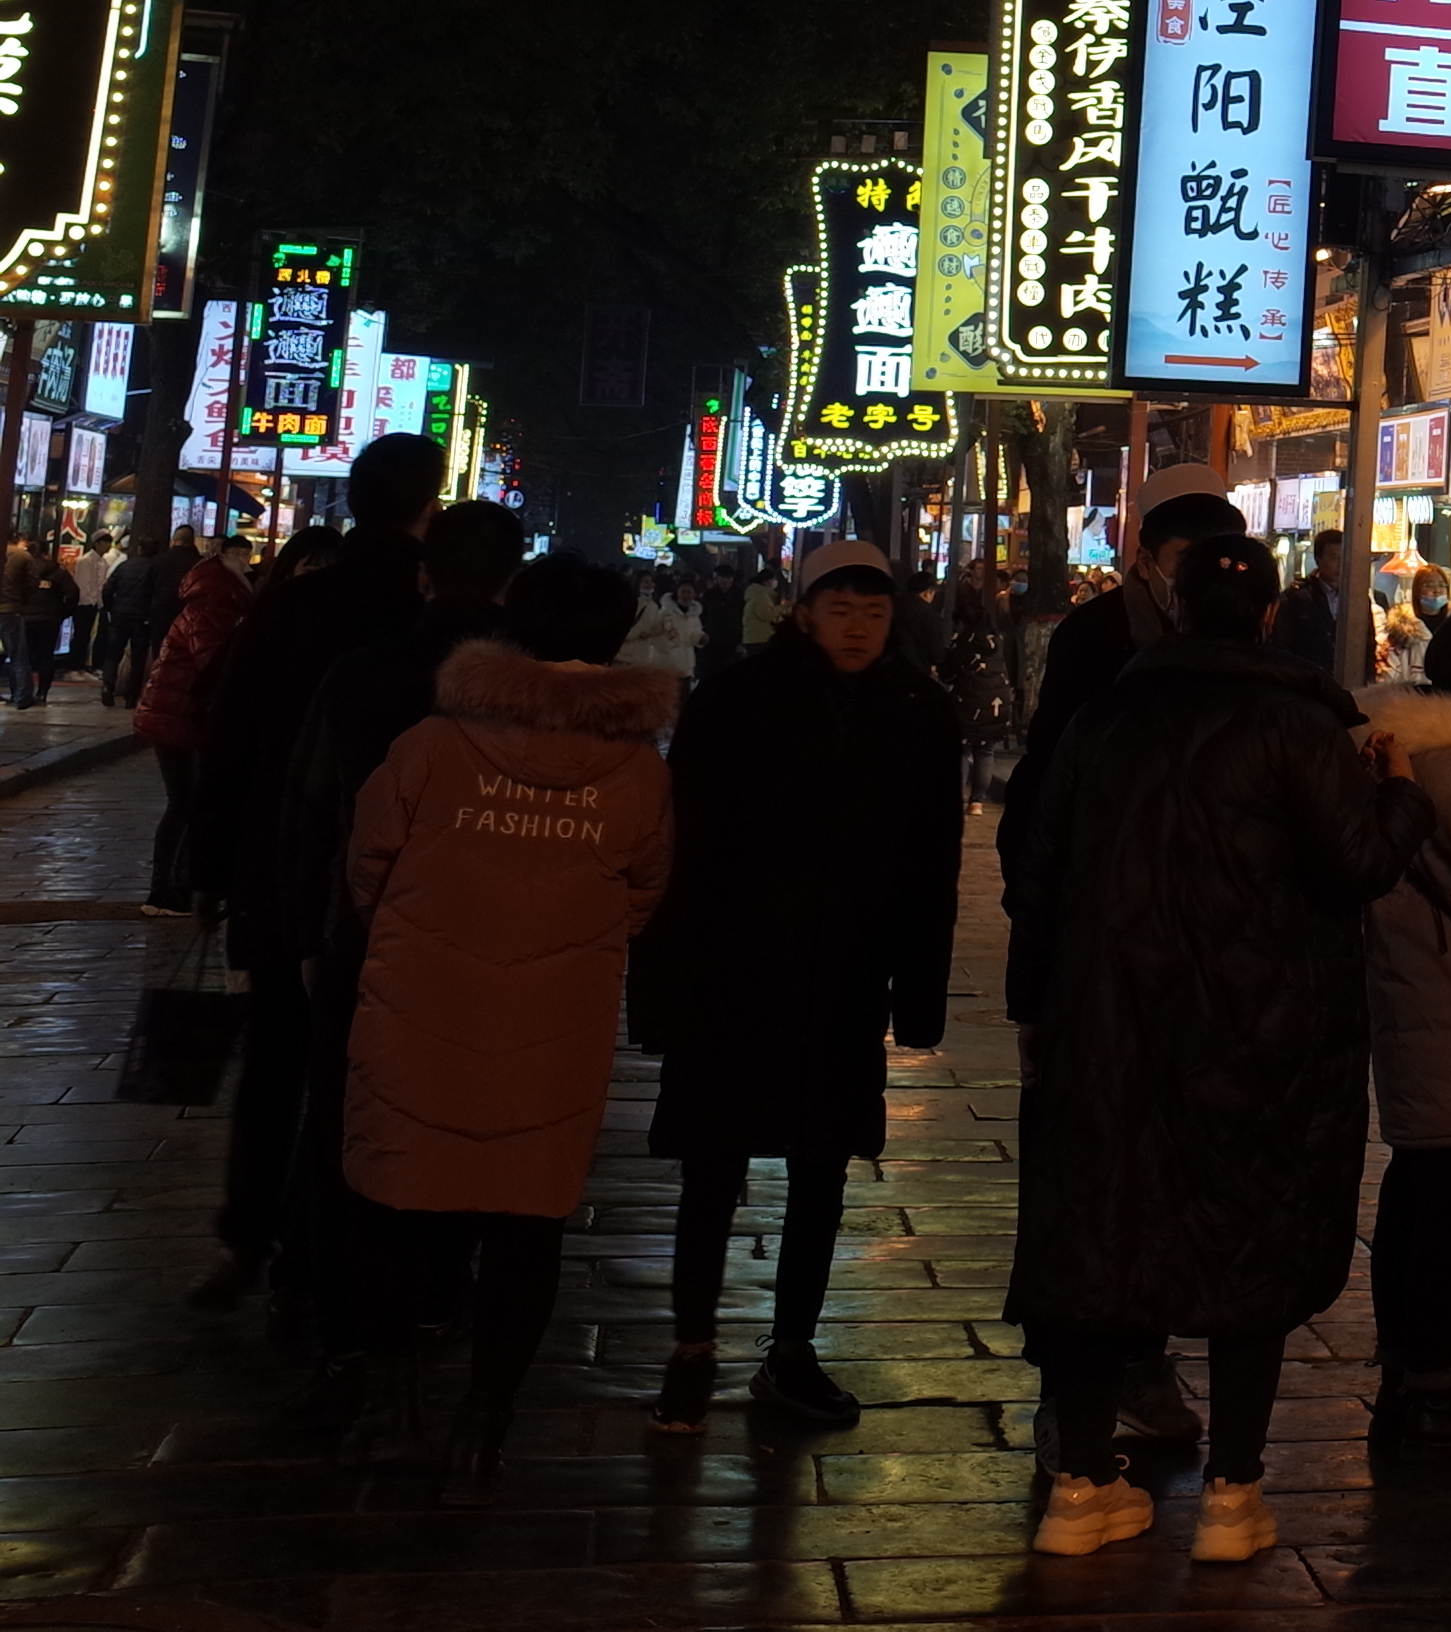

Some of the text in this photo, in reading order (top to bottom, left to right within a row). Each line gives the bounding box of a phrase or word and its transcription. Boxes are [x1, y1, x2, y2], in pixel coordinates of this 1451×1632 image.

[391, 357, 417, 381] 都
[252, 412, 329, 436] 牛肉面
[821, 402, 941, 432] 老字号
[479, 773, 600, 809] WINTER
[454, 806, 605, 845] FASHION
